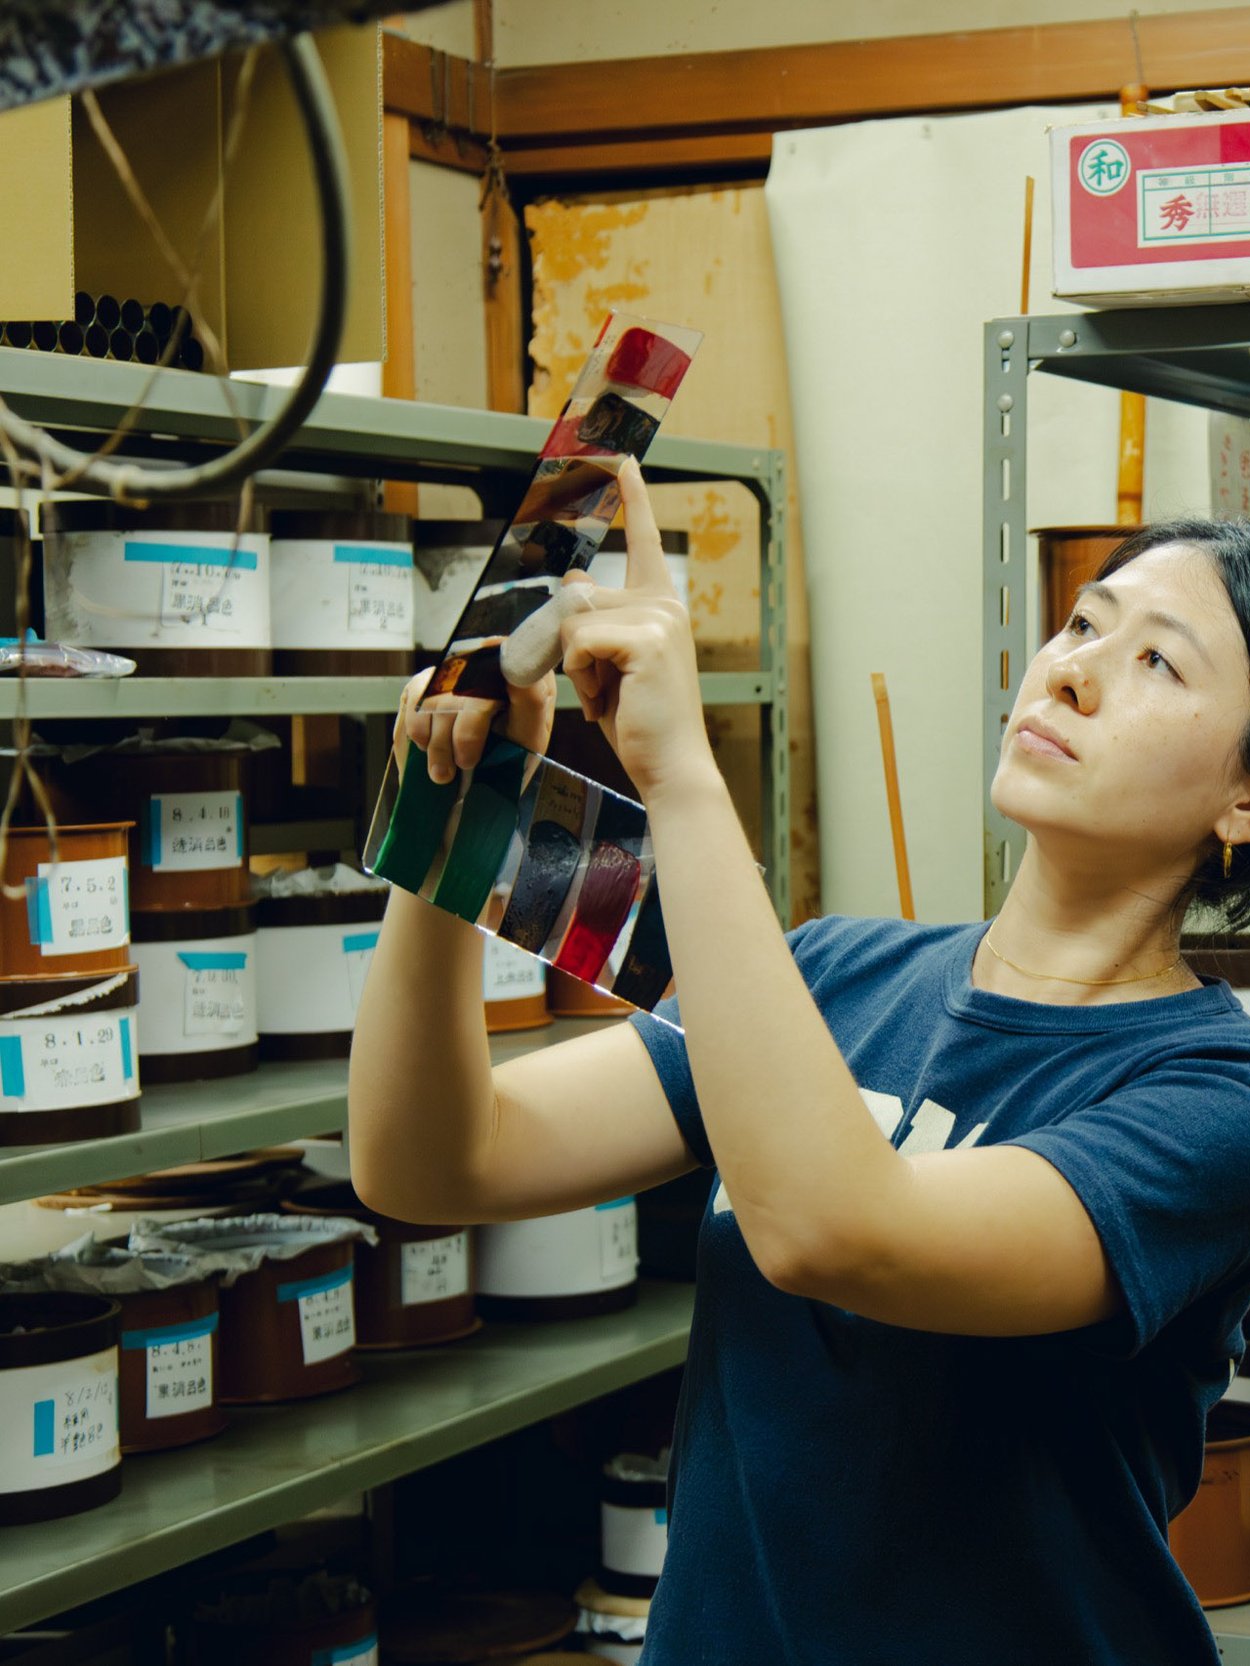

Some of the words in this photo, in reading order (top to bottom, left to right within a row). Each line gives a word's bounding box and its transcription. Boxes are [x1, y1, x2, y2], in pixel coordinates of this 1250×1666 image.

[1088, 149, 1124, 187] 和
[1160, 194, 1194, 231] 秀
[61, 876, 116, 893] 7.5.2
[45, 1027, 113, 1049] 8.1.29
